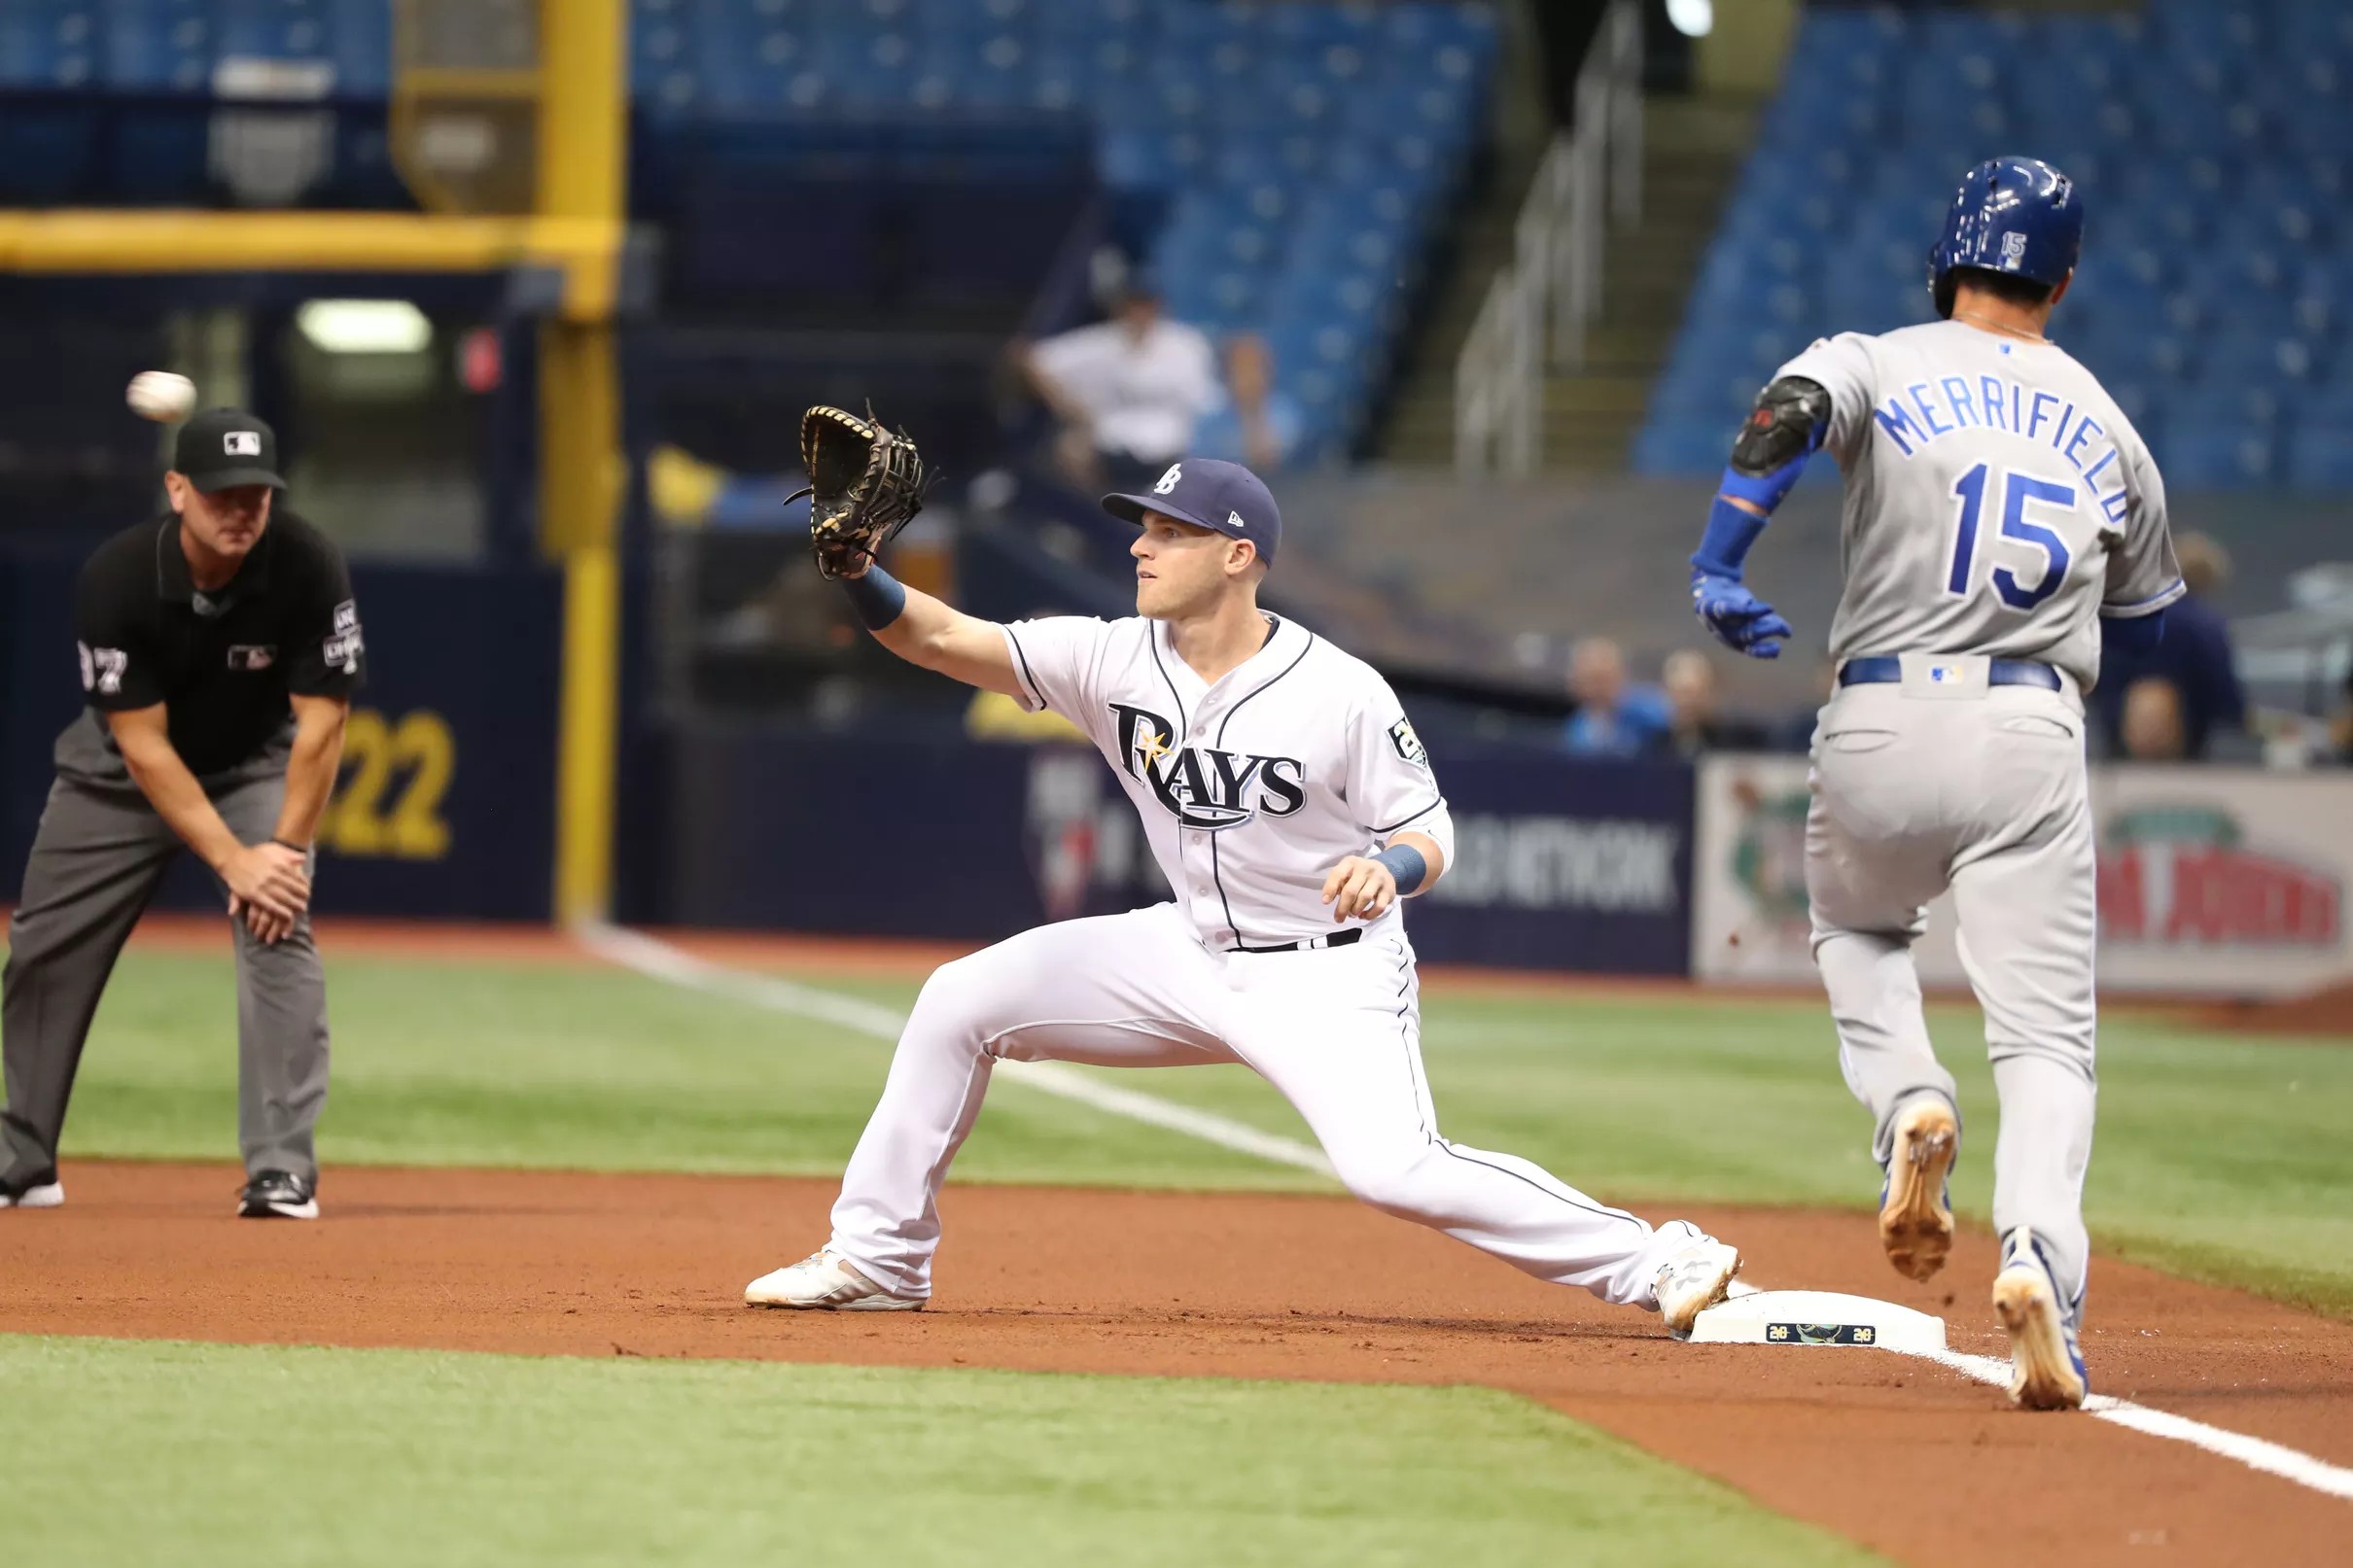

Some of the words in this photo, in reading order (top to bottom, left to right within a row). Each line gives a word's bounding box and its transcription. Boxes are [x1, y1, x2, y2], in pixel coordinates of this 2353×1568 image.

[2001, 231, 2027, 259] 15
[1947, 462, 2077, 611] 15
[1106, 702, 1307, 830] RAYS
